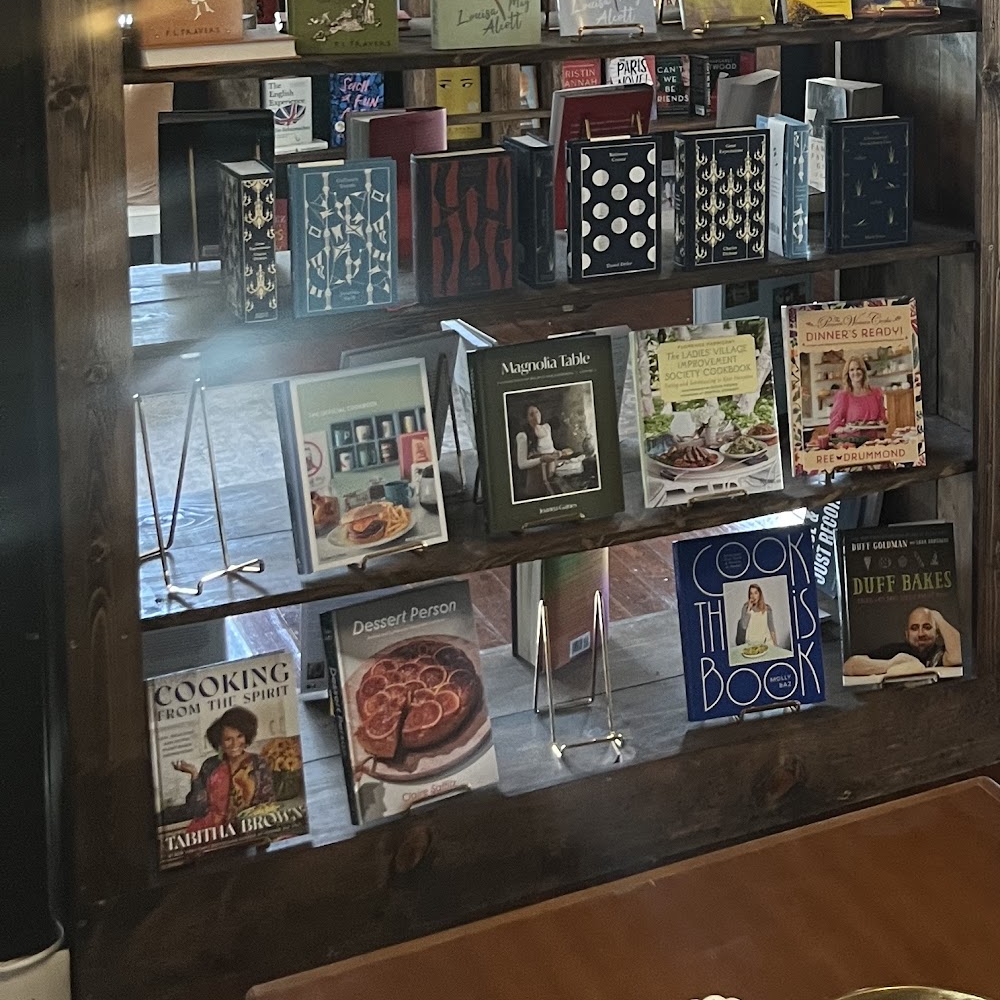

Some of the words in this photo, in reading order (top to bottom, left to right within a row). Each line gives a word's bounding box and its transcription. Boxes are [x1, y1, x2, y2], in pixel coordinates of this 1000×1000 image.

[457, 5, 498, 26] Louisa
[595, 6, 635, 25] Alcott
[181, 27, 220, 35] TRAVERS
[482, 13, 523, 36] Alcott
[565, 68, 596, 78] RISTIN
[617, 59, 647, 77] PARIS
[657, 65, 683, 73] CAN'T
[564, 78, 598, 87] ANNAH
[269, 91, 294, 99] English
[353, 94, 380, 108] FUN
[805, 329, 858, 342] DINNER'S
[861, 326, 903, 338] READY!
[667, 352, 680, 361] The
[713, 344, 747, 355] VILLAGE
[501, 356, 557, 376] Magnolia
[558, 351, 591, 368] Table
[677, 355, 738, 369] IMPROVEMENT
[665, 369, 700, 381] SOCIETY
[703, 364, 752, 377] COOKBOOK
[816, 454, 836, 465] REE
[842, 449, 906, 463] DRUMMOND
[851, 541, 870, 551] DUFF
[873, 540, 908, 550] GOLDMAN
[693, 534, 810, 597] COOK
[813, 544, 832, 586] JUST
[852, 575, 896, 596] DUFF
[901, 570, 952, 592] BAKES
[352, 610, 407, 636] Dessert
[409, 601, 457, 622] Person
[154, 662, 289, 707] COOKING
[701, 641, 820, 712] BOOK
[770, 673, 792, 683] MOLLY
[779, 680, 792, 688] BAZ
[157, 703, 201, 722] FROM
[207, 695, 237, 711] THE
[244, 684, 290, 704] SPIRIT
[165, 822, 237, 851] TABITHA
[241, 806, 304, 833] BROWN
